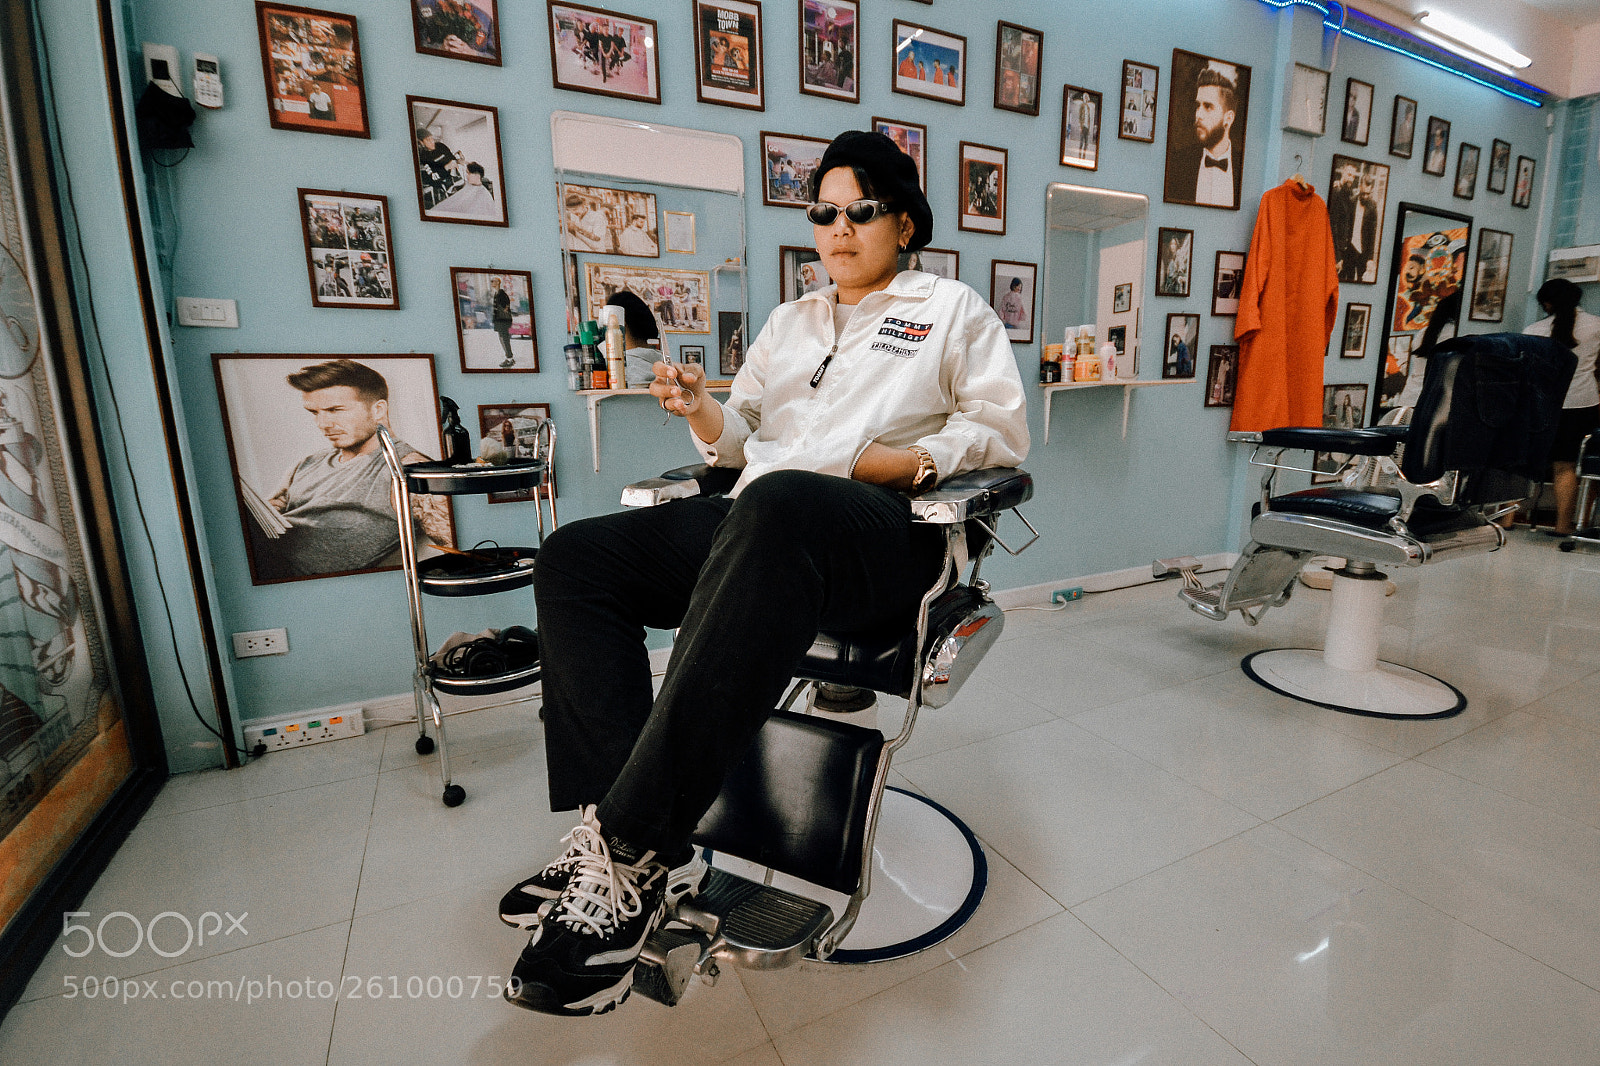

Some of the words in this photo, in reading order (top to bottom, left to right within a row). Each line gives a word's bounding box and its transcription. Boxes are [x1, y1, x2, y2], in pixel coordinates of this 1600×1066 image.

[717, 9, 739, 22] MOBB
[717, 19, 739, 30] TOWN
[887, 318, 930, 330] TOMMY
[881, 328, 925, 341] HILFIGER
[812, 364, 826, 384] TOMMY
